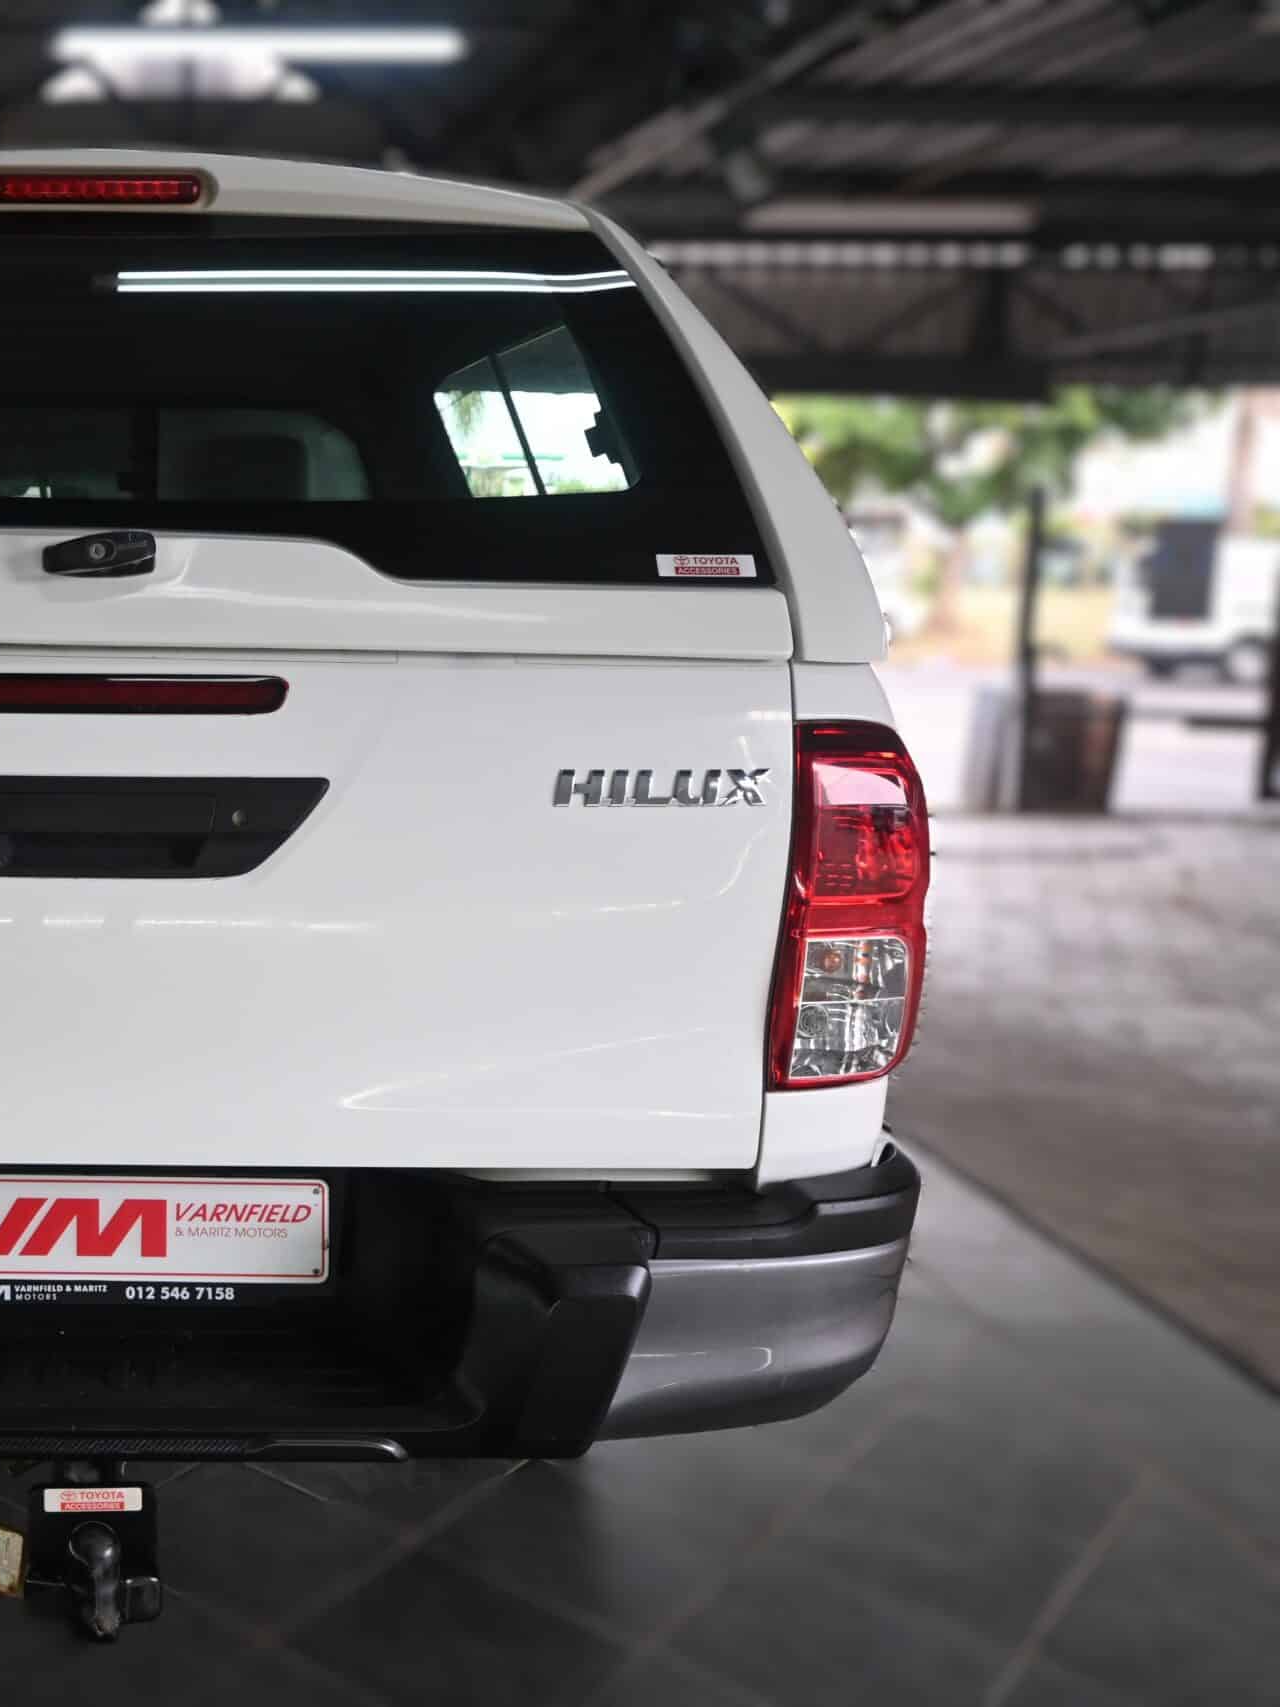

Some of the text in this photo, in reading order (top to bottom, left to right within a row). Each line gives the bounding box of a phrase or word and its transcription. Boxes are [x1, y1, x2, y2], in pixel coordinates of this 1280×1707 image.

[692, 556, 738, 565] TOYOTA
[552, 767, 770, 807] HILUX
[175, 1202, 312, 1223] VARNFIELD
[187, 1227, 233, 1238] MARITZ
[235, 1227, 288, 1239] MOTORS
[125, 1286, 156, 1300] 012
[161, 1287, 190, 1300] 546
[195, 1287, 235, 1300] 7158
[79, 1492, 124, 1500] TOYOTA
